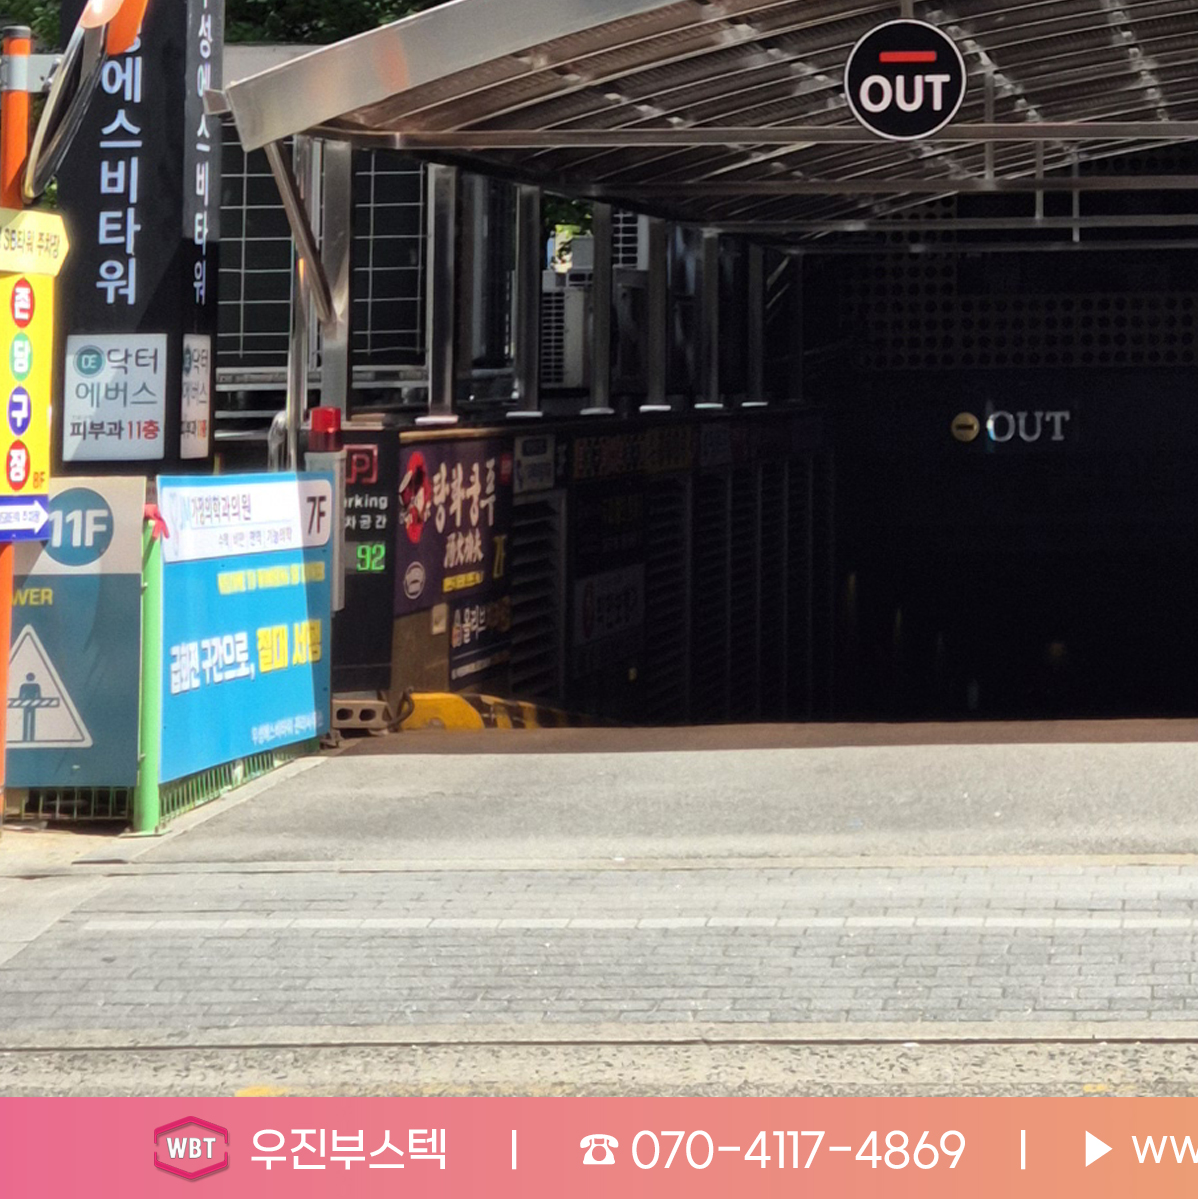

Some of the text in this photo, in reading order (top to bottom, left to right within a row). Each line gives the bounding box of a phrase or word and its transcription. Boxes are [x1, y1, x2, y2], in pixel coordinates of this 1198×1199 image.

[860, 74, 952, 114] OUT
[107, 348, 158, 375] 닥터
[75, 382, 158, 408] 에버스
[70, 420, 124, 441] 피부과
[128, 419, 160, 440] 11층
[989, 411, 1071, 443] OUT
[306, 495, 327, 535] 7F
[344, 494, 388, 510] rking
[49, 509, 108, 548] 11F
[357, 544, 386, 572] 92
[13, 587, 54, 606] WER
